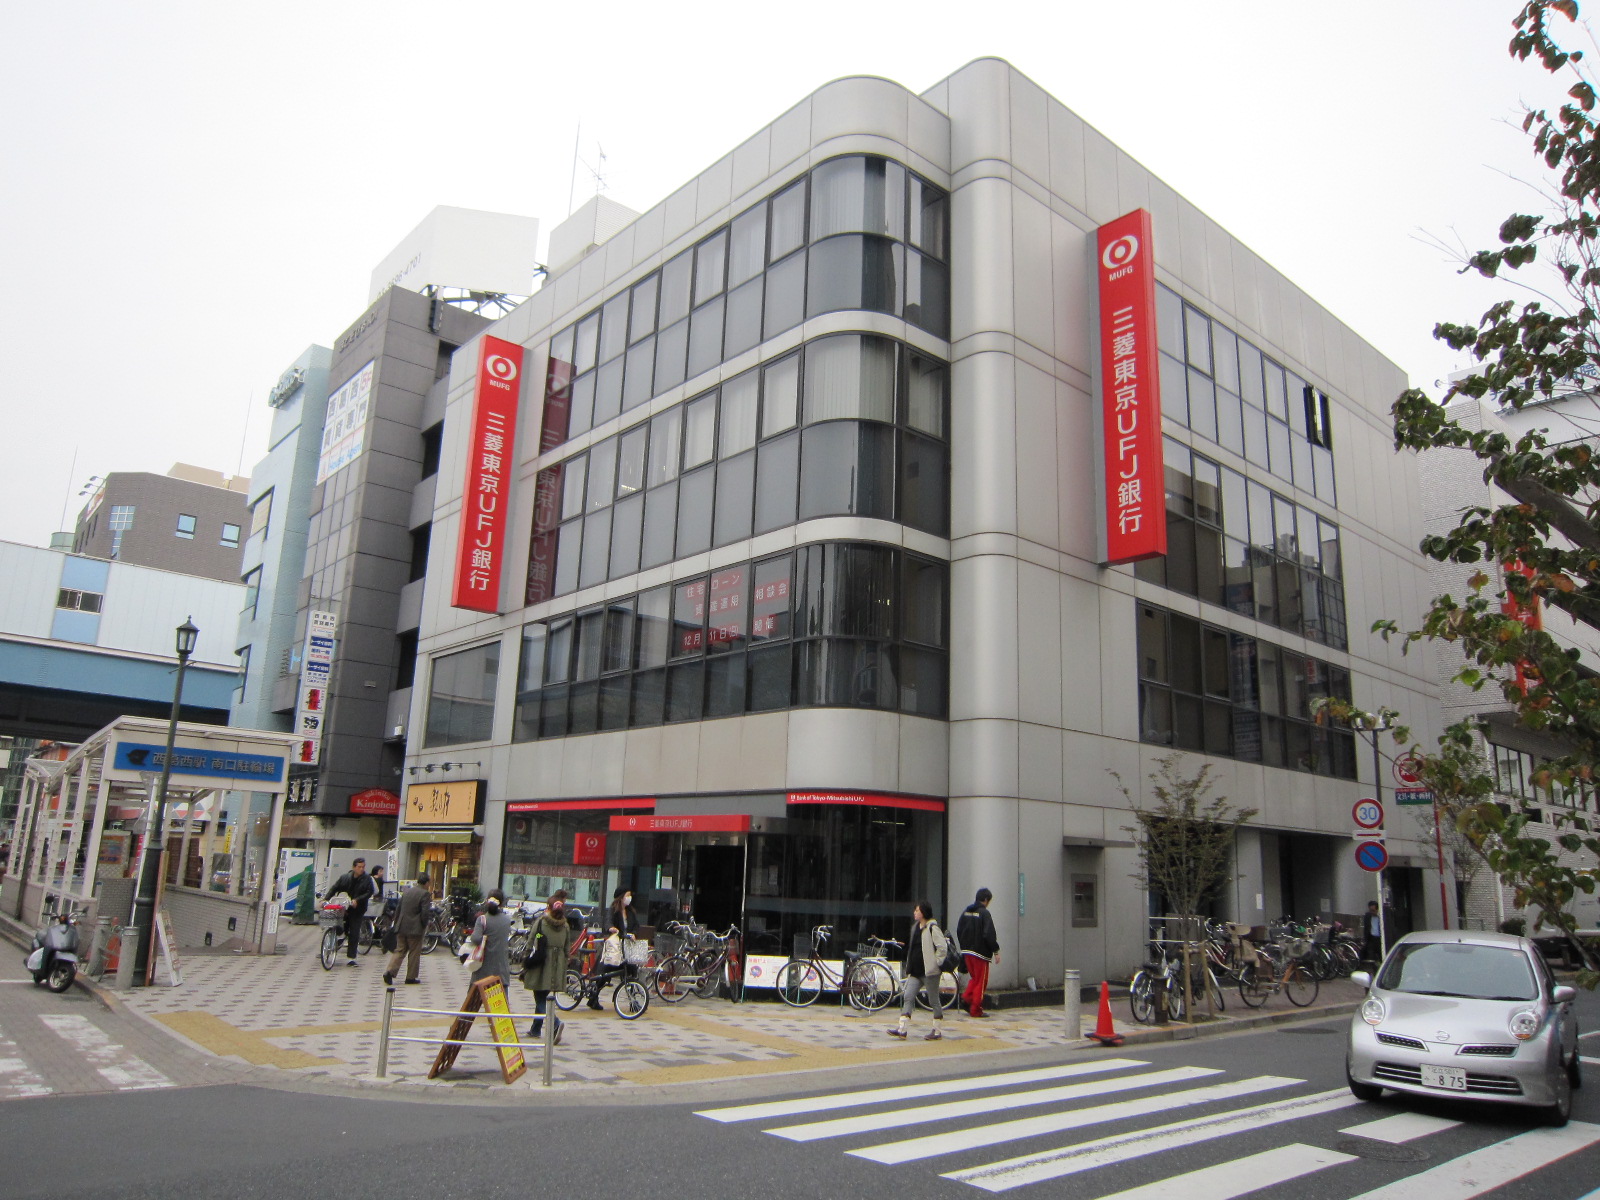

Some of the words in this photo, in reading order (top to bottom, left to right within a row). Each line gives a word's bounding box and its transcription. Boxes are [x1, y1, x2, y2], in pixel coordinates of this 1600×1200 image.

[1109, 265, 1133, 281] MUFG
[489, 379, 511, 391] MUFG
[1112, 305, 1142, 535] 三菱東京UFJ銀行
[469, 411, 505, 591] 三菱東京UFJ銀行
[755, 582, 787, 601] 相談会
[211, 757, 275, 775] 南口駐輪場
[356, 799, 396, 810] Kinjohen
[1359, 806, 1377, 820] 30
